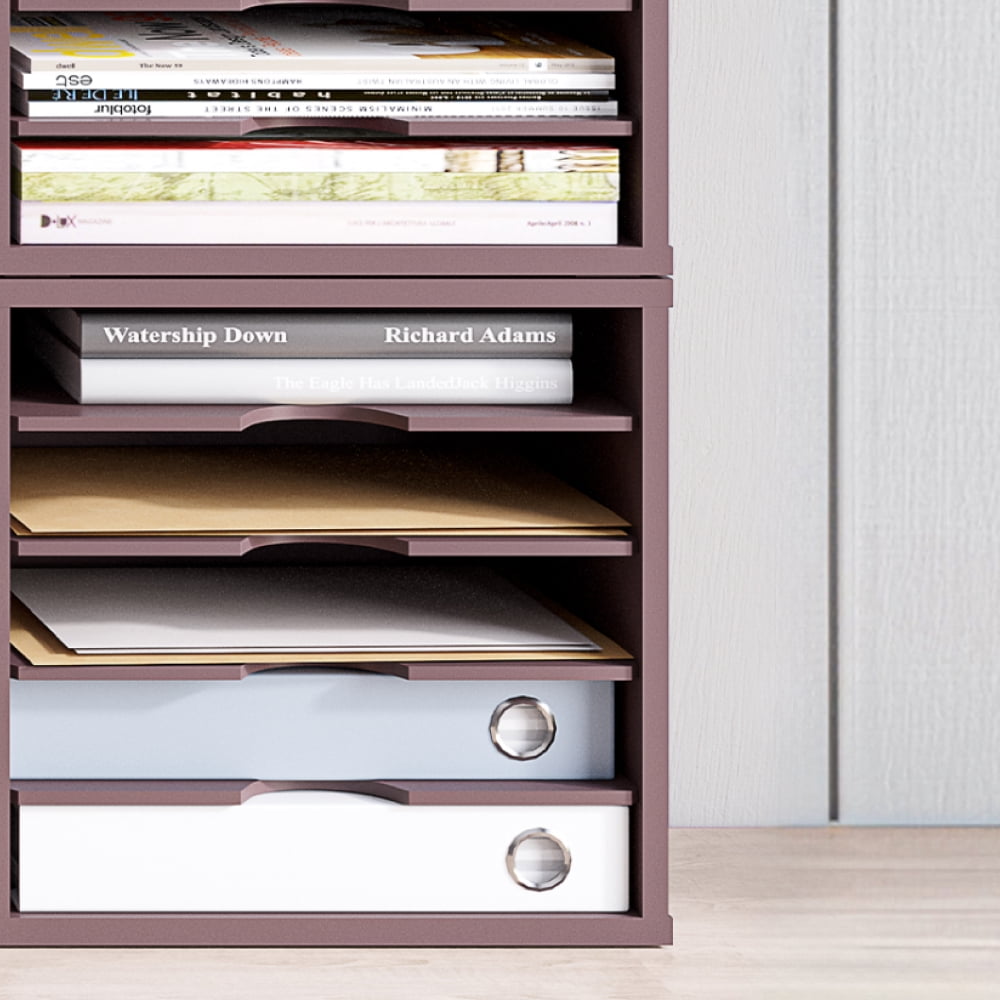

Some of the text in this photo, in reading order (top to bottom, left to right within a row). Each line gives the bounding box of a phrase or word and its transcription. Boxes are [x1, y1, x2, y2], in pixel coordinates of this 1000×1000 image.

[55, 74, 94, 87] est
[81, 89, 107, 101] DE
[186, 91, 331, 100] habitat
[94, 103, 152, 115] fotoblur
[203, 105, 433, 113] MINIMALISM SCENES OF THE STREET
[103, 327, 288, 347] Watership Down
[384, 327, 556, 343] Richard Adams
[274, 376, 304, 390] The
[309, 376, 352, 393] Eagle
[359, 376, 389, 390] Has
[495, 376, 558, 393] Higgins
